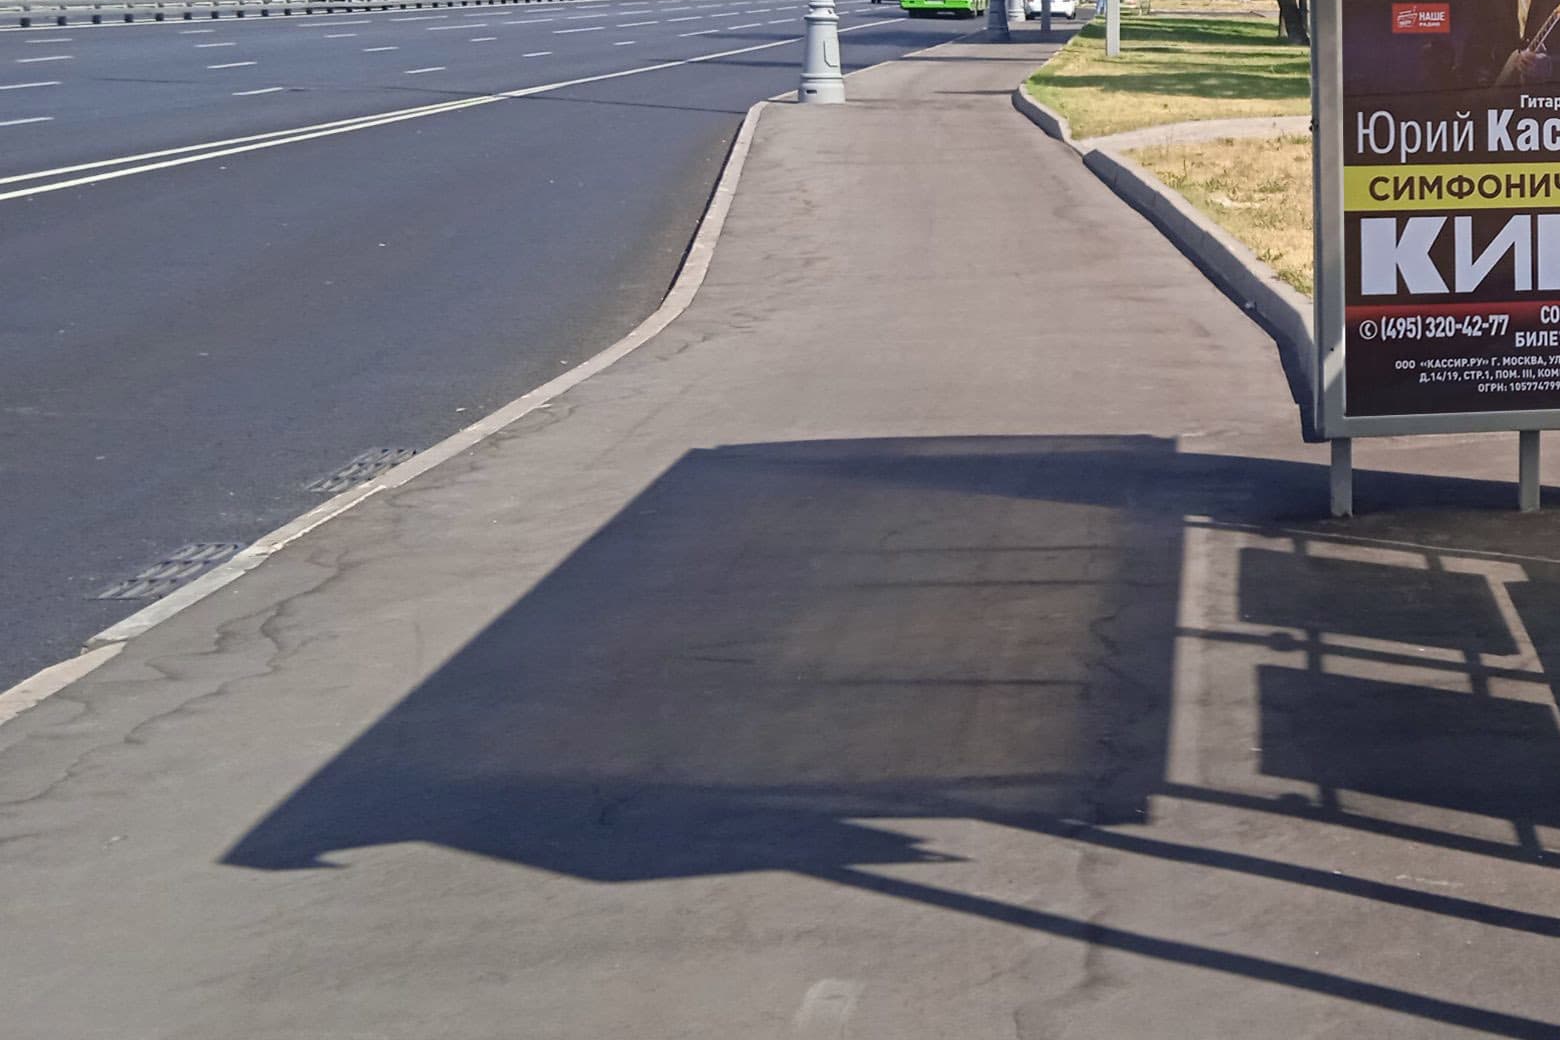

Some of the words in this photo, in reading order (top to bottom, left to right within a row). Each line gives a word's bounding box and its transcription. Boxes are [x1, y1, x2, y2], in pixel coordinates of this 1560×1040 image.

[1419, 11, 1446, 22] НАШЕ
[1357, 111, 1475, 163] Юрий
[1381, 315, 1422, 341] (495)
[1425, 314, 1509, 338] 320-42-77
[1395, 360, 1416, 369] ООО
[1502, 356, 1547, 367] МОСКВА,
[1419, 371, 1462, 383] Д.14/19,
[1463, 371, 1494, 381] СТР.1,
[1495, 369, 1521, 379] ПОМ.
[1478, 382, 1508, 392] ОГРН:
